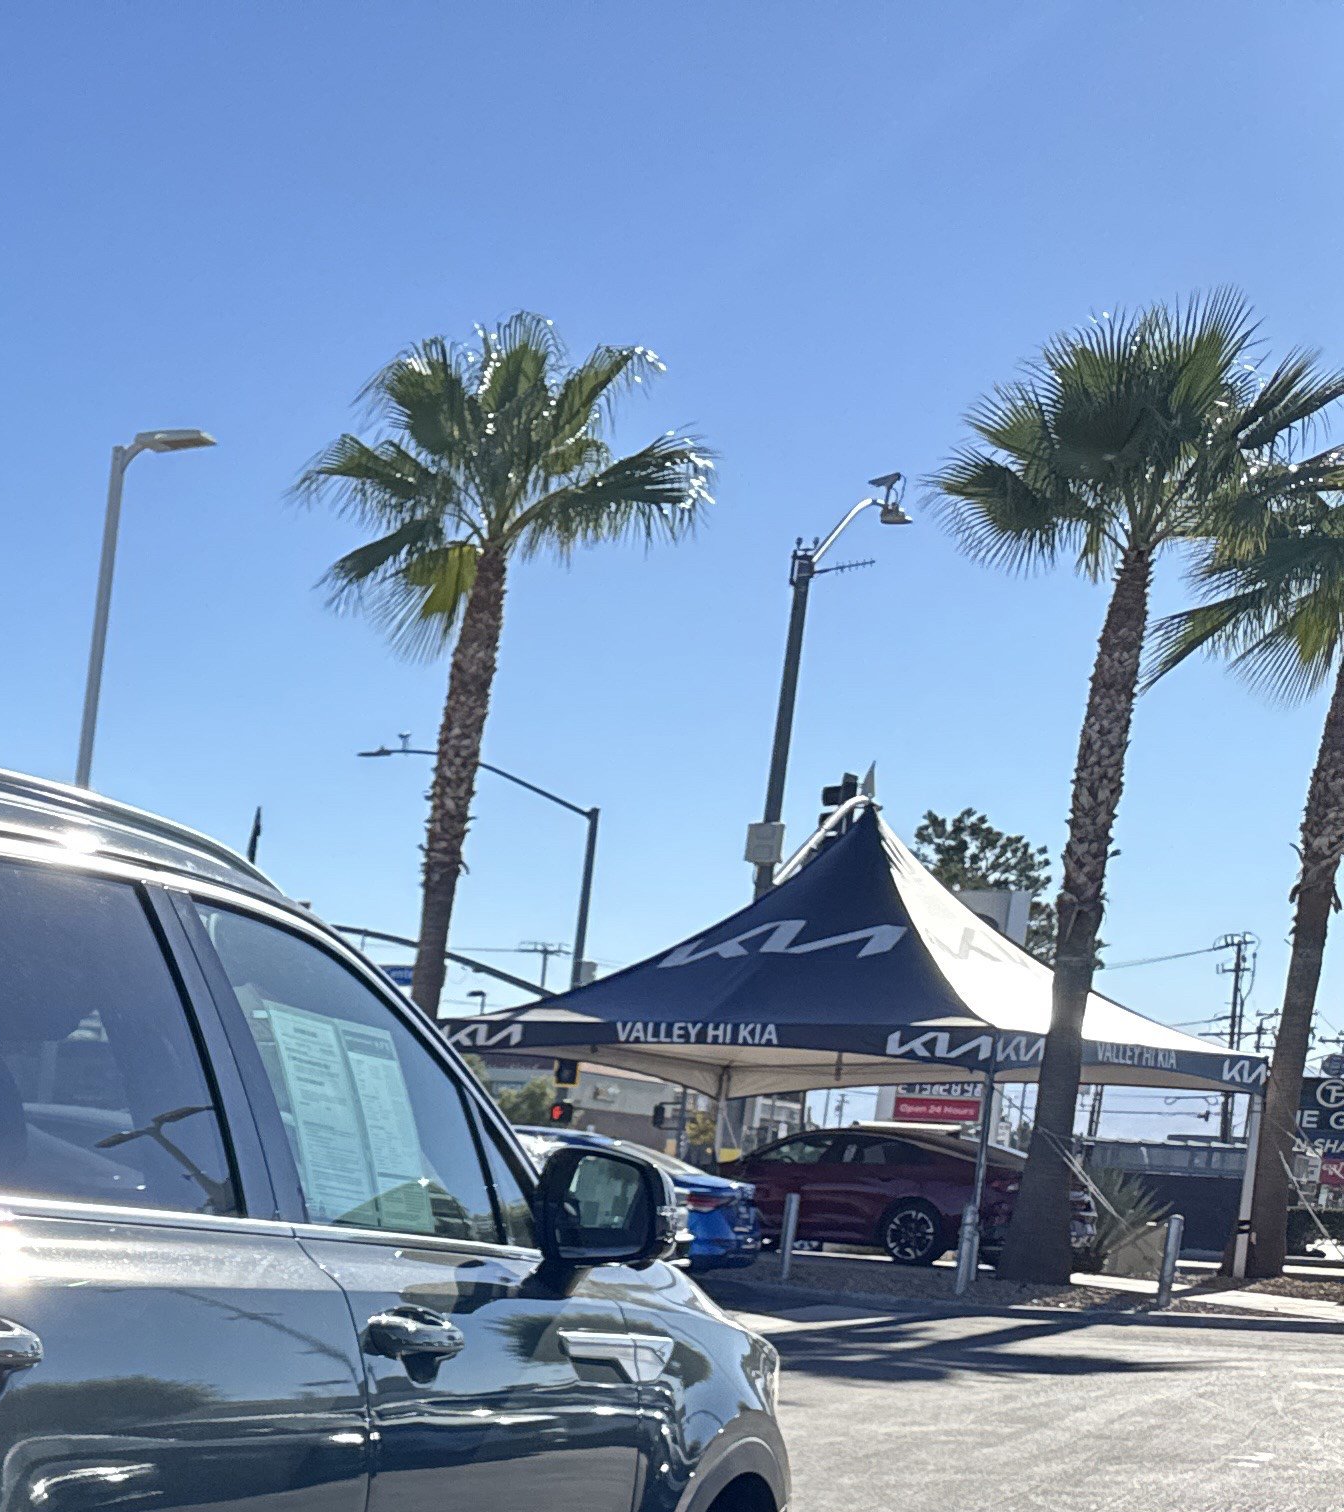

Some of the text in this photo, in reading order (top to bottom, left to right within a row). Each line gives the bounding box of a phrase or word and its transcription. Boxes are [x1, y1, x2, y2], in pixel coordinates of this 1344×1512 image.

[657, 919, 908, 969] KIA
[616, 1021, 778, 1045] VALLEY HI KIA
[886, 1030, 993, 1061] KIA
[1096, 1041, 1177, 1070] VALLEY HI KIA
[1222, 1058, 1267, 1085] KIA
